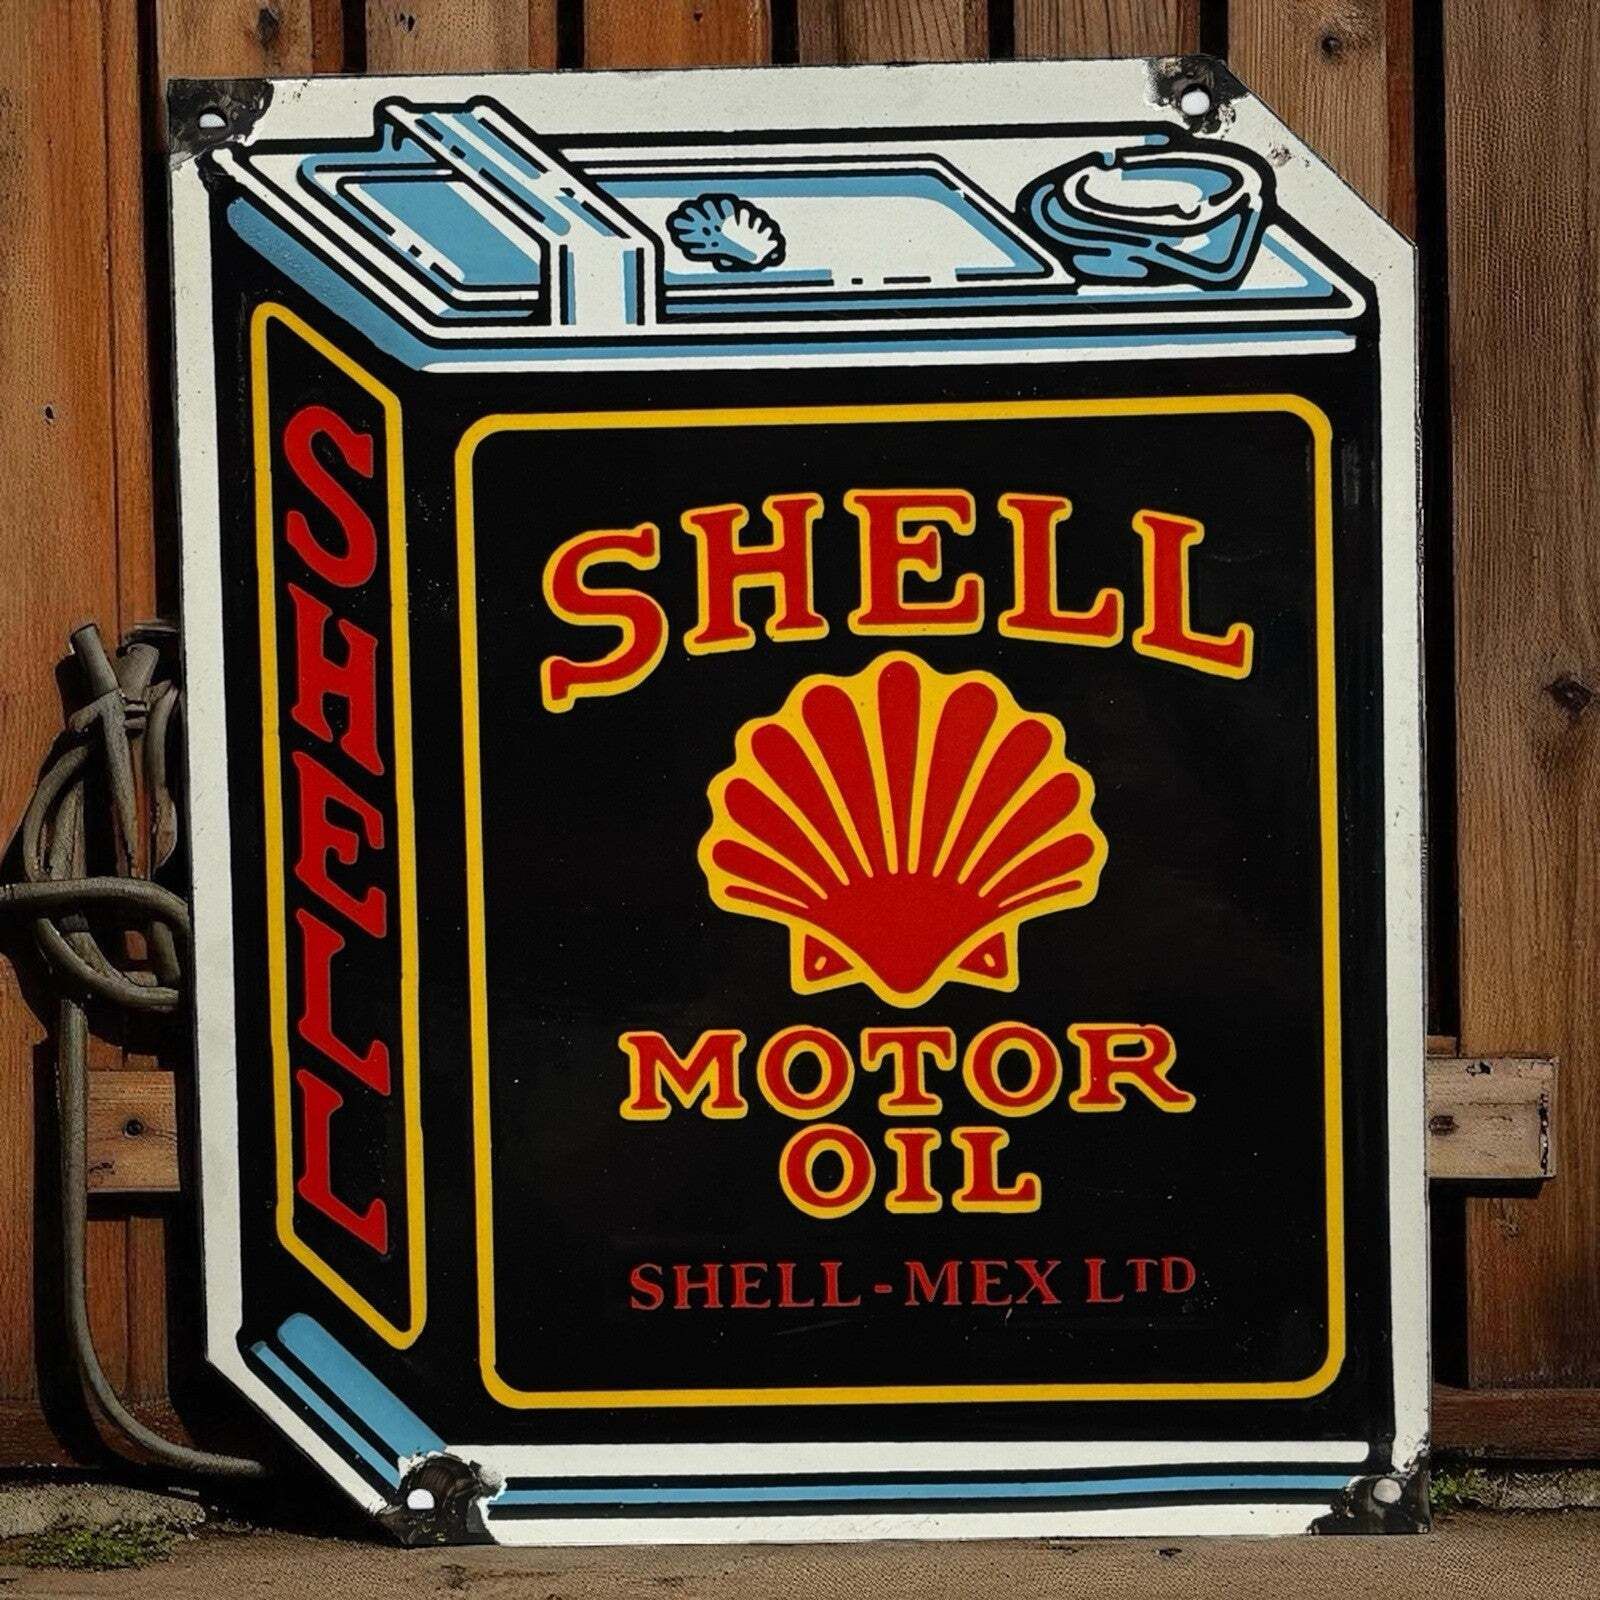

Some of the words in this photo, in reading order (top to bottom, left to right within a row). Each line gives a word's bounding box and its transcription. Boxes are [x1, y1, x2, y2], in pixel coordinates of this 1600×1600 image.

[540, 488, 1254, 714] SHELL
[284, 405, 391, 1253] SHELL
[618, 1022, 1196, 1122] MOTOR
[779, 1123, 1042, 1220] OIL
